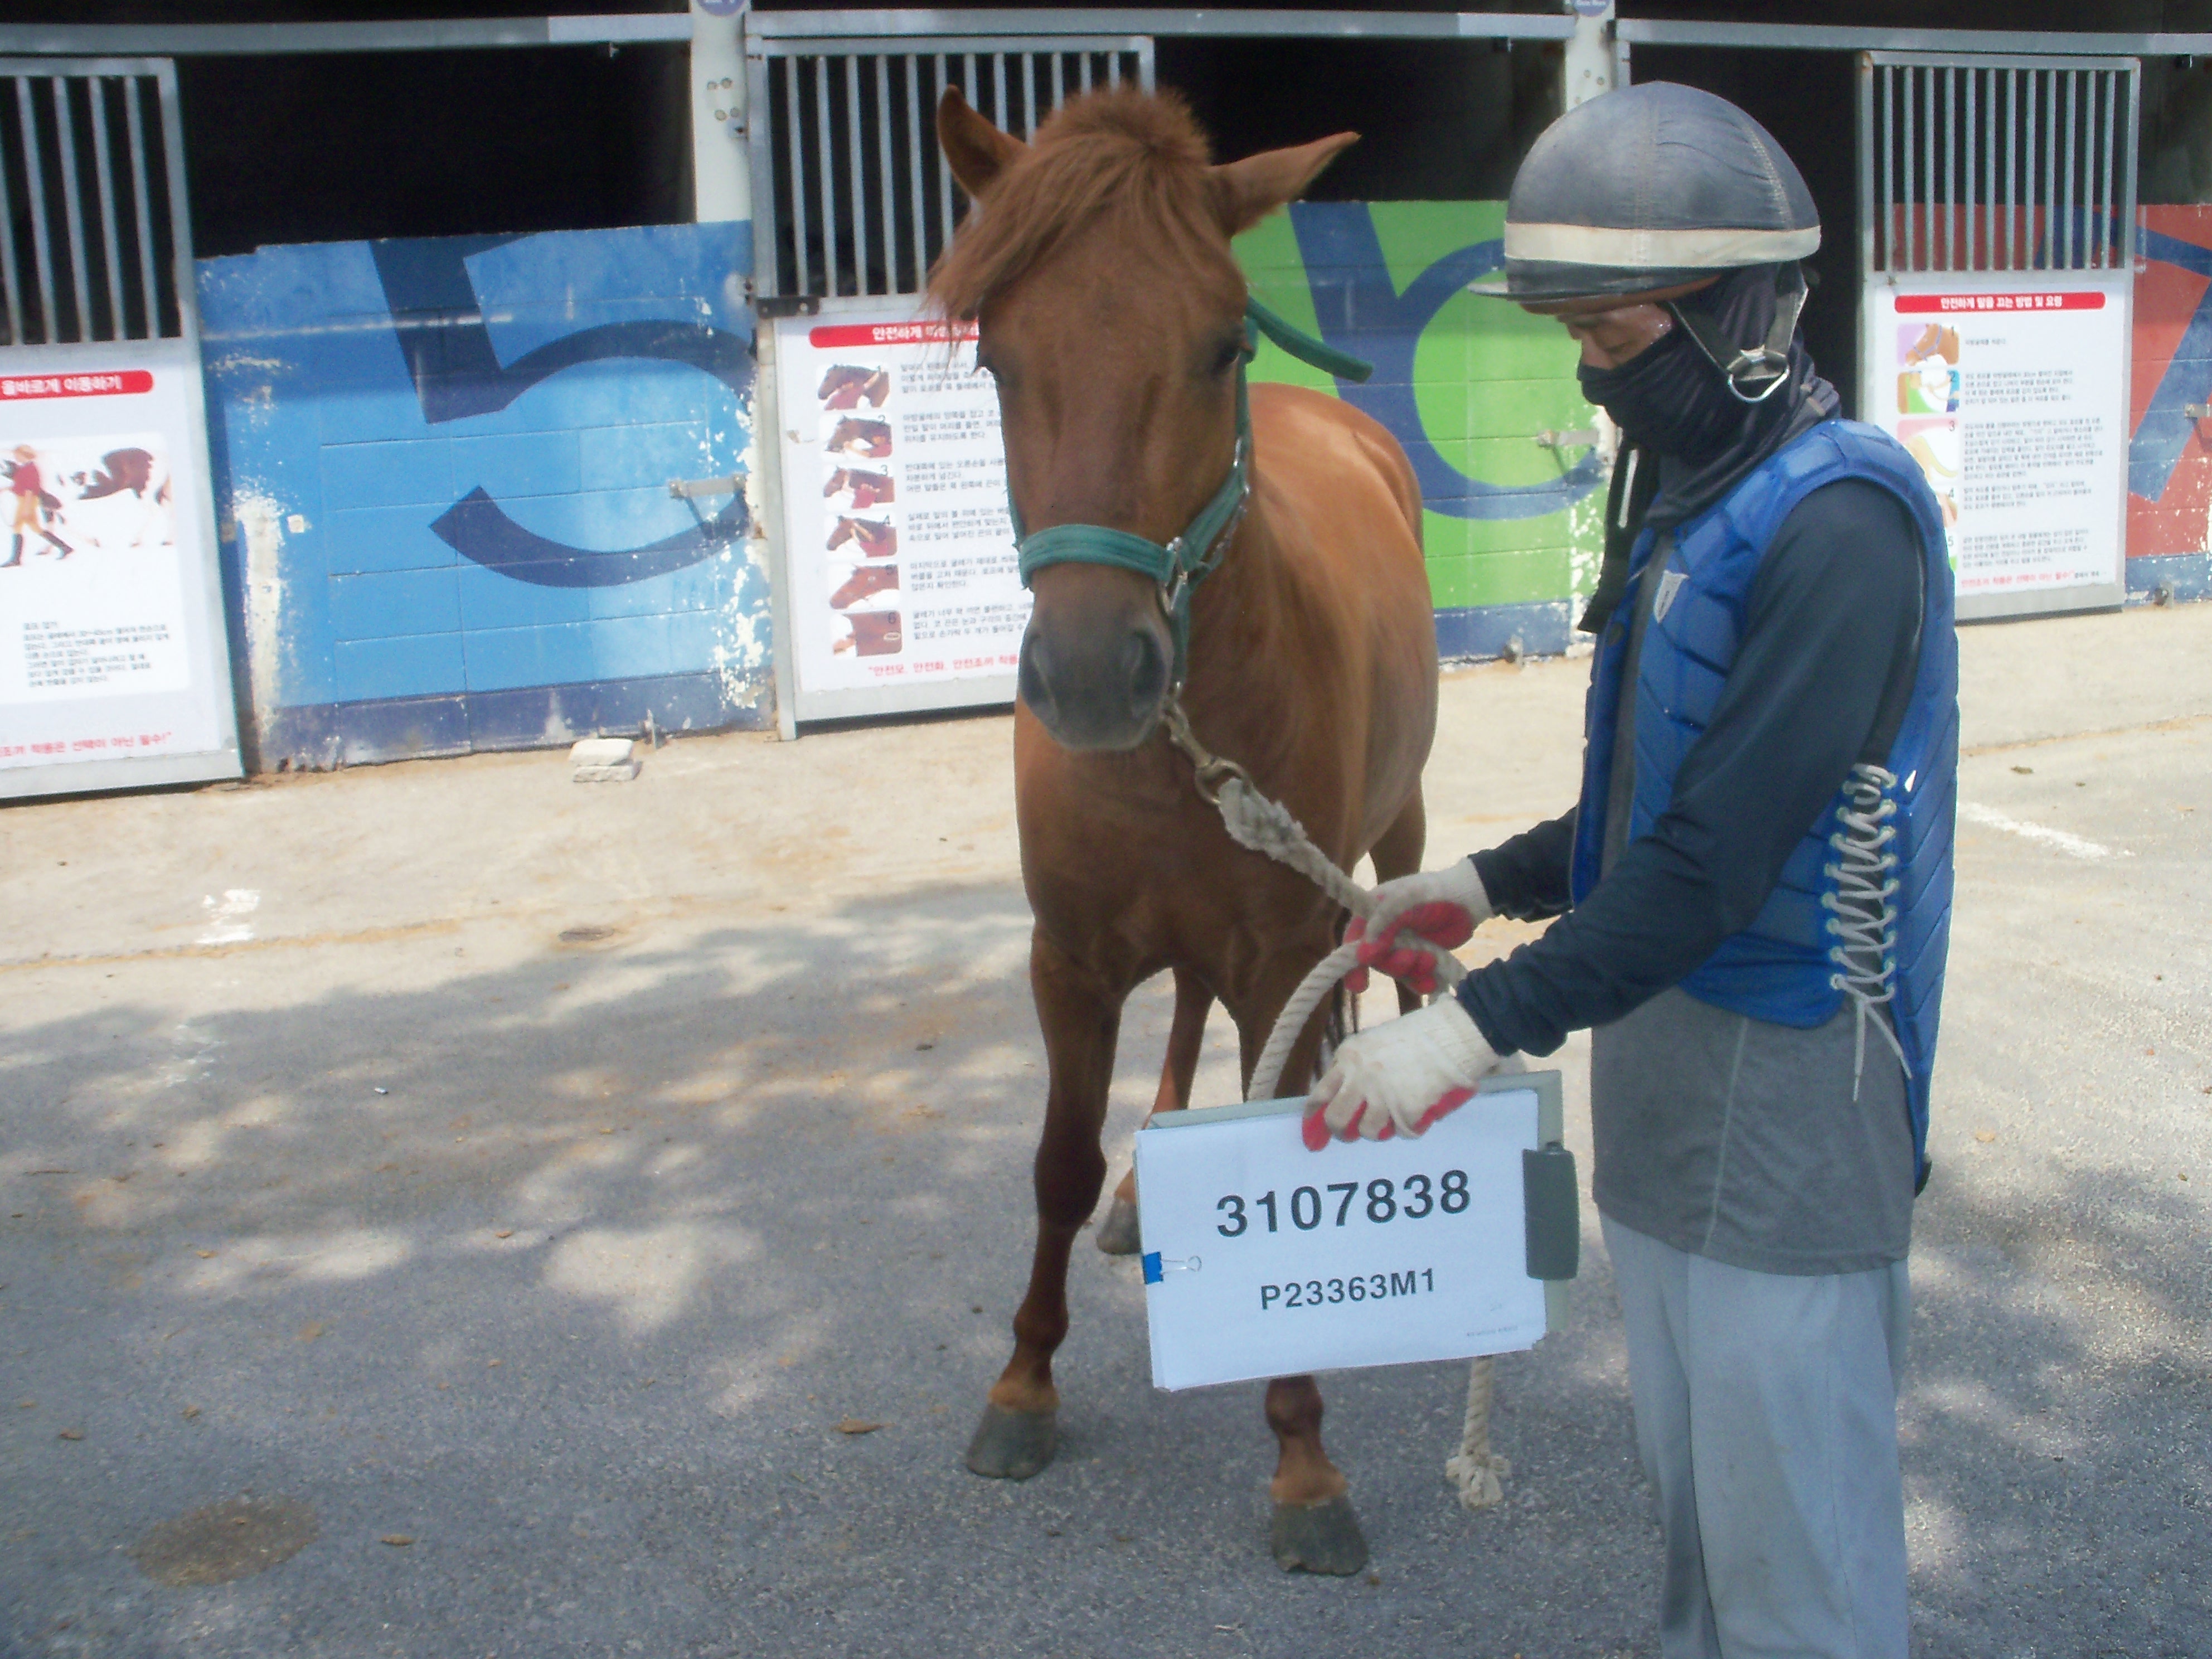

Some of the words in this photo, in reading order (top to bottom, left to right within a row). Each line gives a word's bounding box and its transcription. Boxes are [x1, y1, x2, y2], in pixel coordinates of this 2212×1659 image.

[872, 326, 921, 341] 안전하게
[1216, 1169, 1471, 1238] 3107838
[1260, 1267, 1435, 1311] P23363M1
